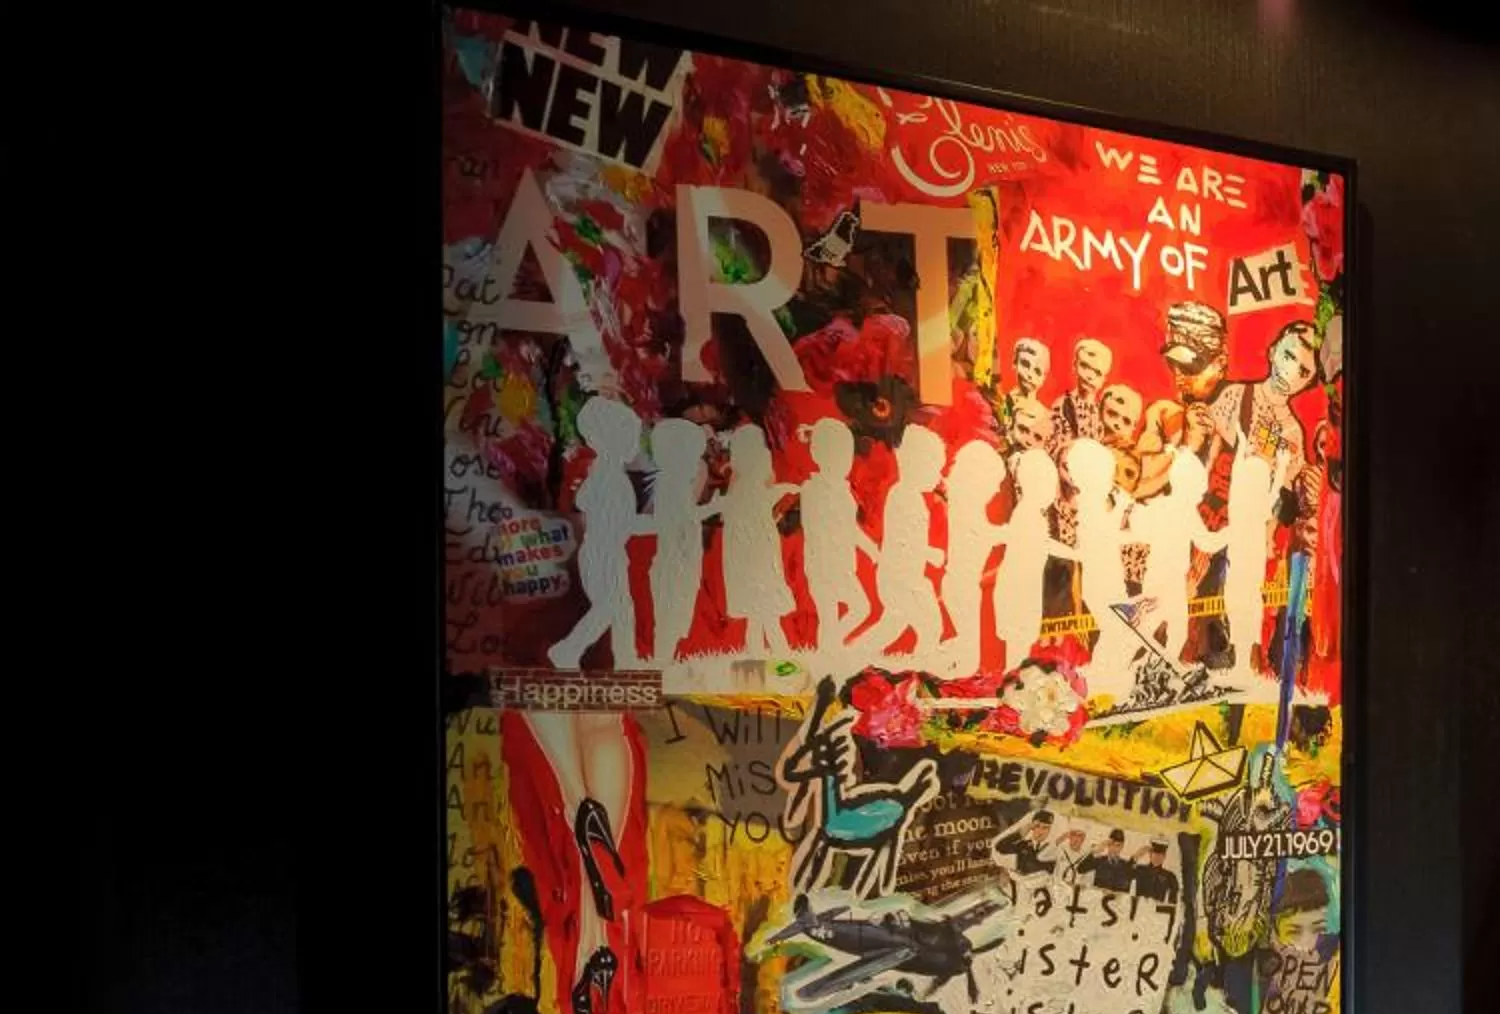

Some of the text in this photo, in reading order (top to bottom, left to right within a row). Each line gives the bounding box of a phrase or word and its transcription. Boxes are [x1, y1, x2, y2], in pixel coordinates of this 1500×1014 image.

[500, 43, 673, 168] NEW
[1095, 139, 1248, 209] WE ARE
[1020, 209, 1209, 290] ARMY OF
[1147, 196, 1201, 235] AN
[456, 165, 978, 406] ART
[1229, 249, 1297, 307] Art
[500, 675, 658, 709] Happiness
